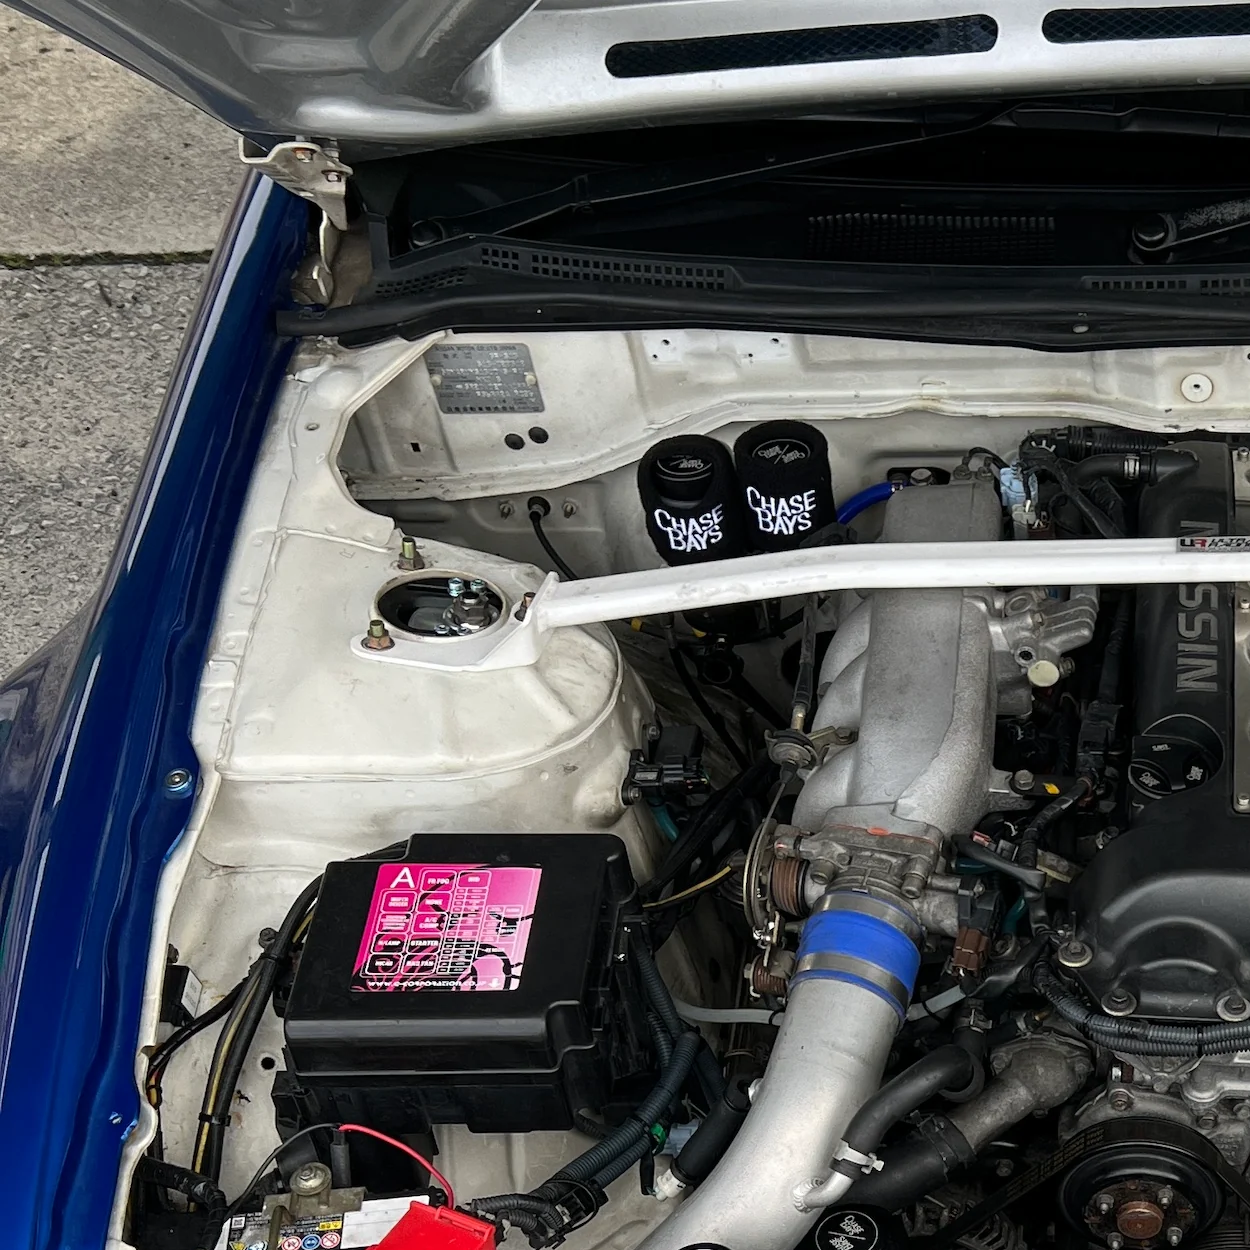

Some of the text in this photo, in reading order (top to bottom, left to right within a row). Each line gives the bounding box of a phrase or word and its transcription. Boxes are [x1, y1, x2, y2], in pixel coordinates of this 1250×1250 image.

[746, 486, 817, 517] CHASE
[654, 504, 724, 535] CHASE
[757, 508, 812, 535] BAYS
[668, 525, 723, 552] BAYS
[390, 867, 415, 889] A
